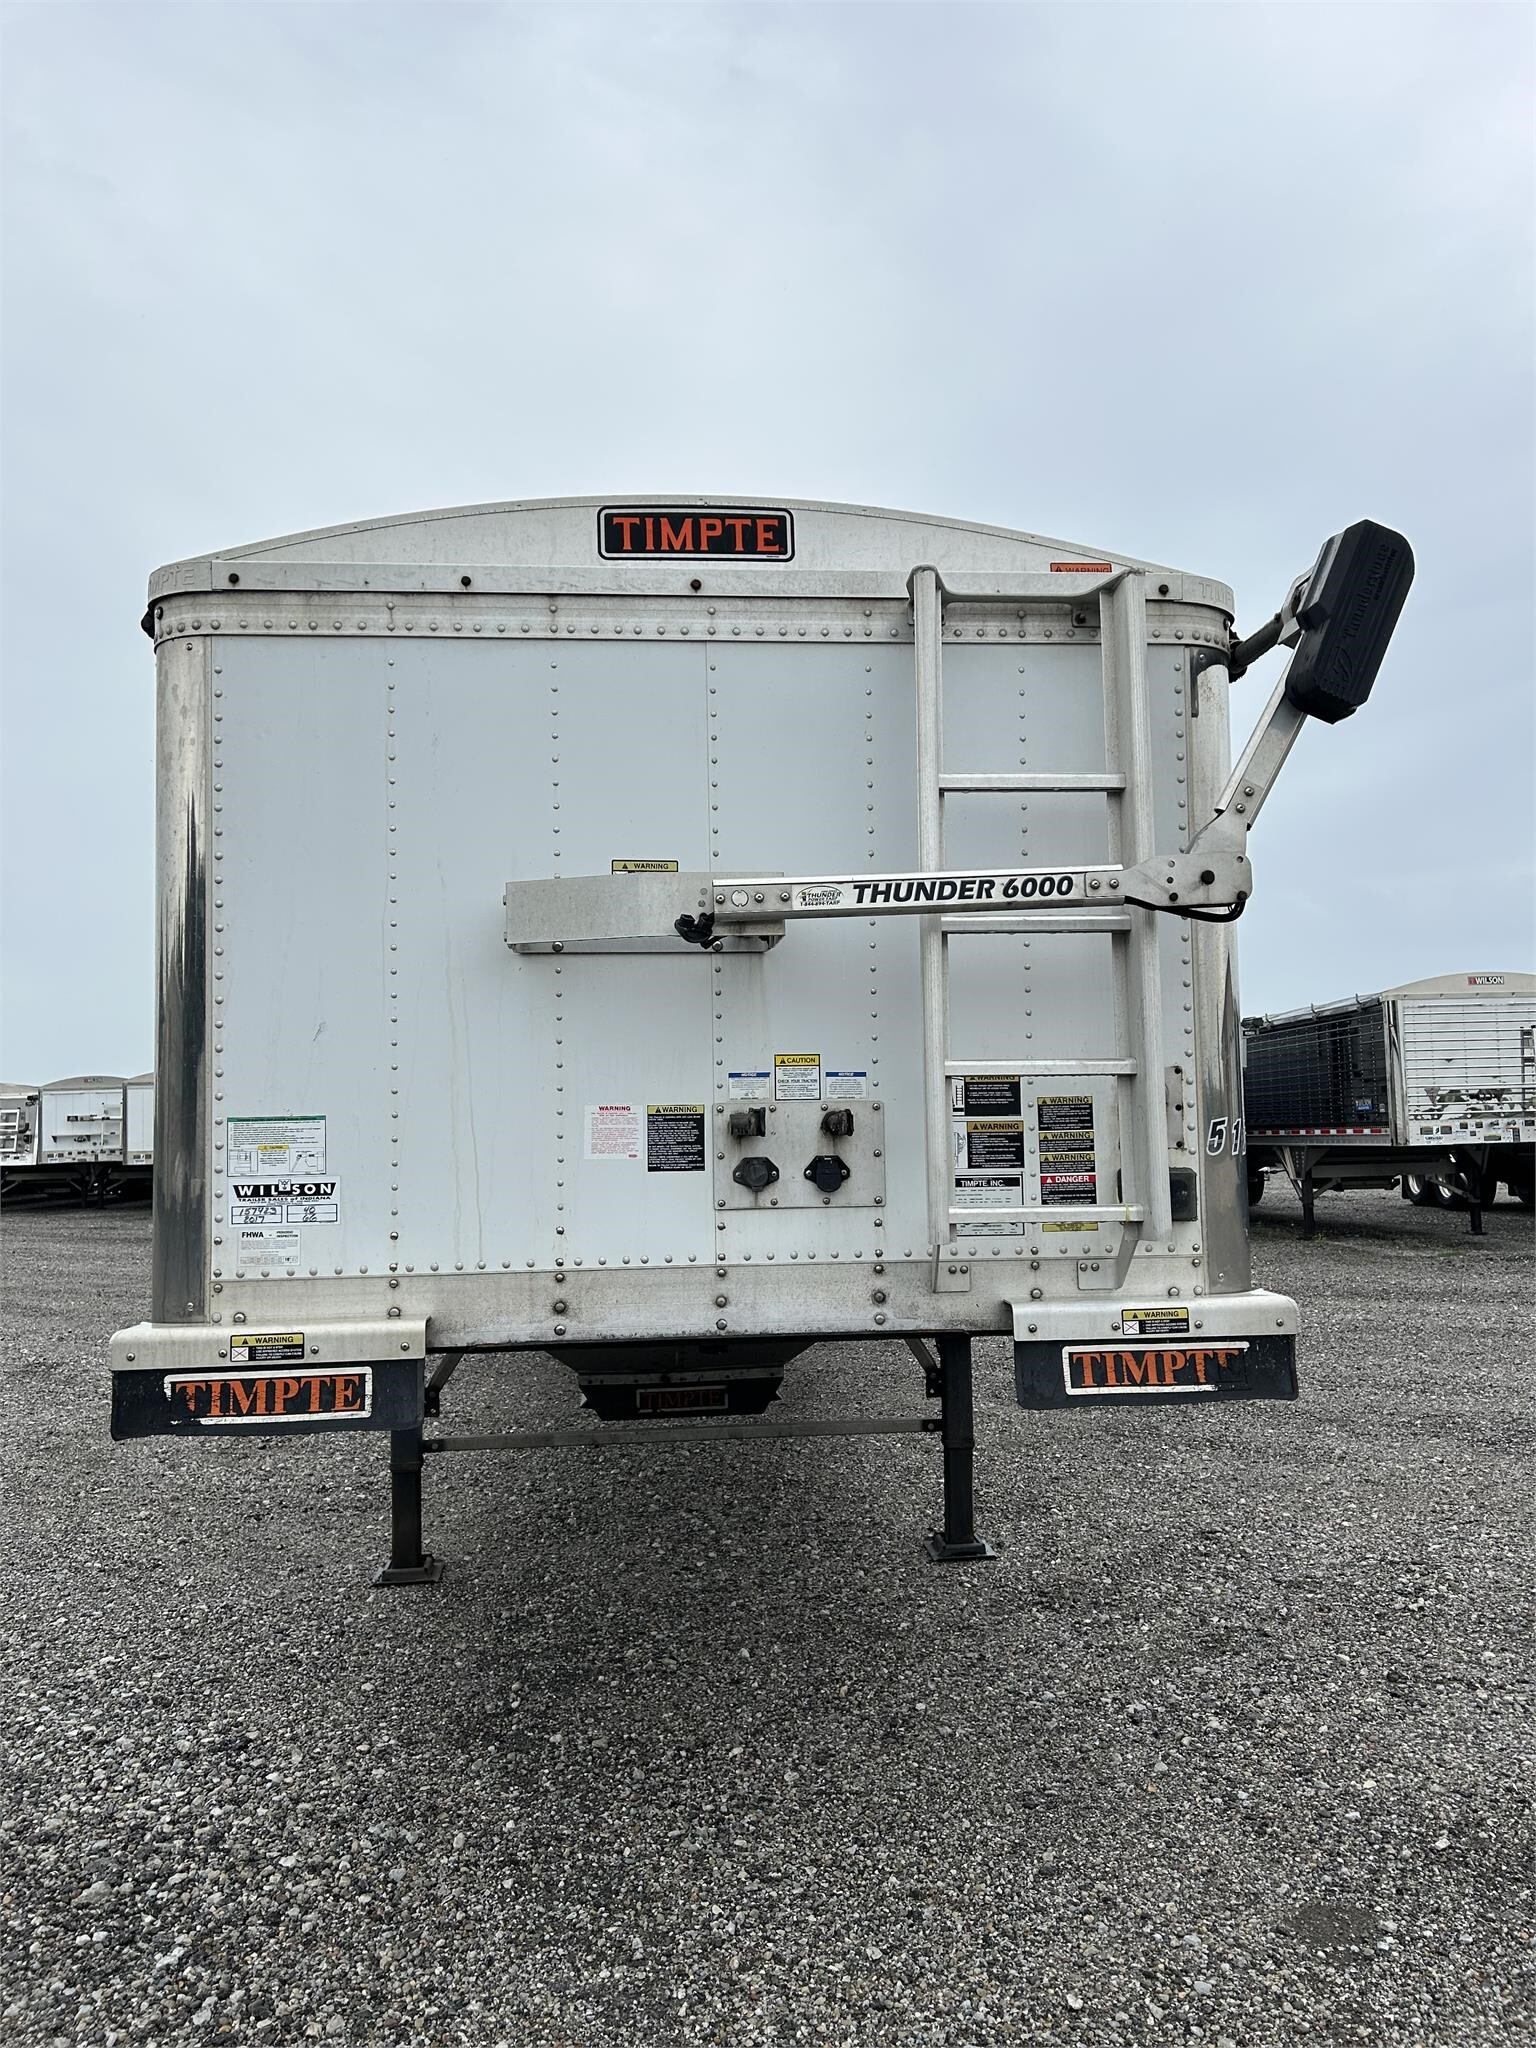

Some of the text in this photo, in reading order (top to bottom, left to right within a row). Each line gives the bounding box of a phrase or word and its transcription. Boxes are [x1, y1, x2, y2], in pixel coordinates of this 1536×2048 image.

[612, 517, 780, 552] TIMPTE
[852, 875, 1074, 904] THUNDER 6000
[1475, 976, 1504, 985] WILSON
[1050, 1096, 1090, 1104] WARNING
[1052, 1153, 1093, 1161] WARNING
[238, 1184, 333, 1196] WILSON
[303, 1206, 316, 1214] 40
[1143, 1310, 1179, 1318] WARNING
[255, 1336, 294, 1344] WARNING
[175, 1375, 361, 1416] TIMPTE
[642, 1390, 720, 1408] TIMPTE
